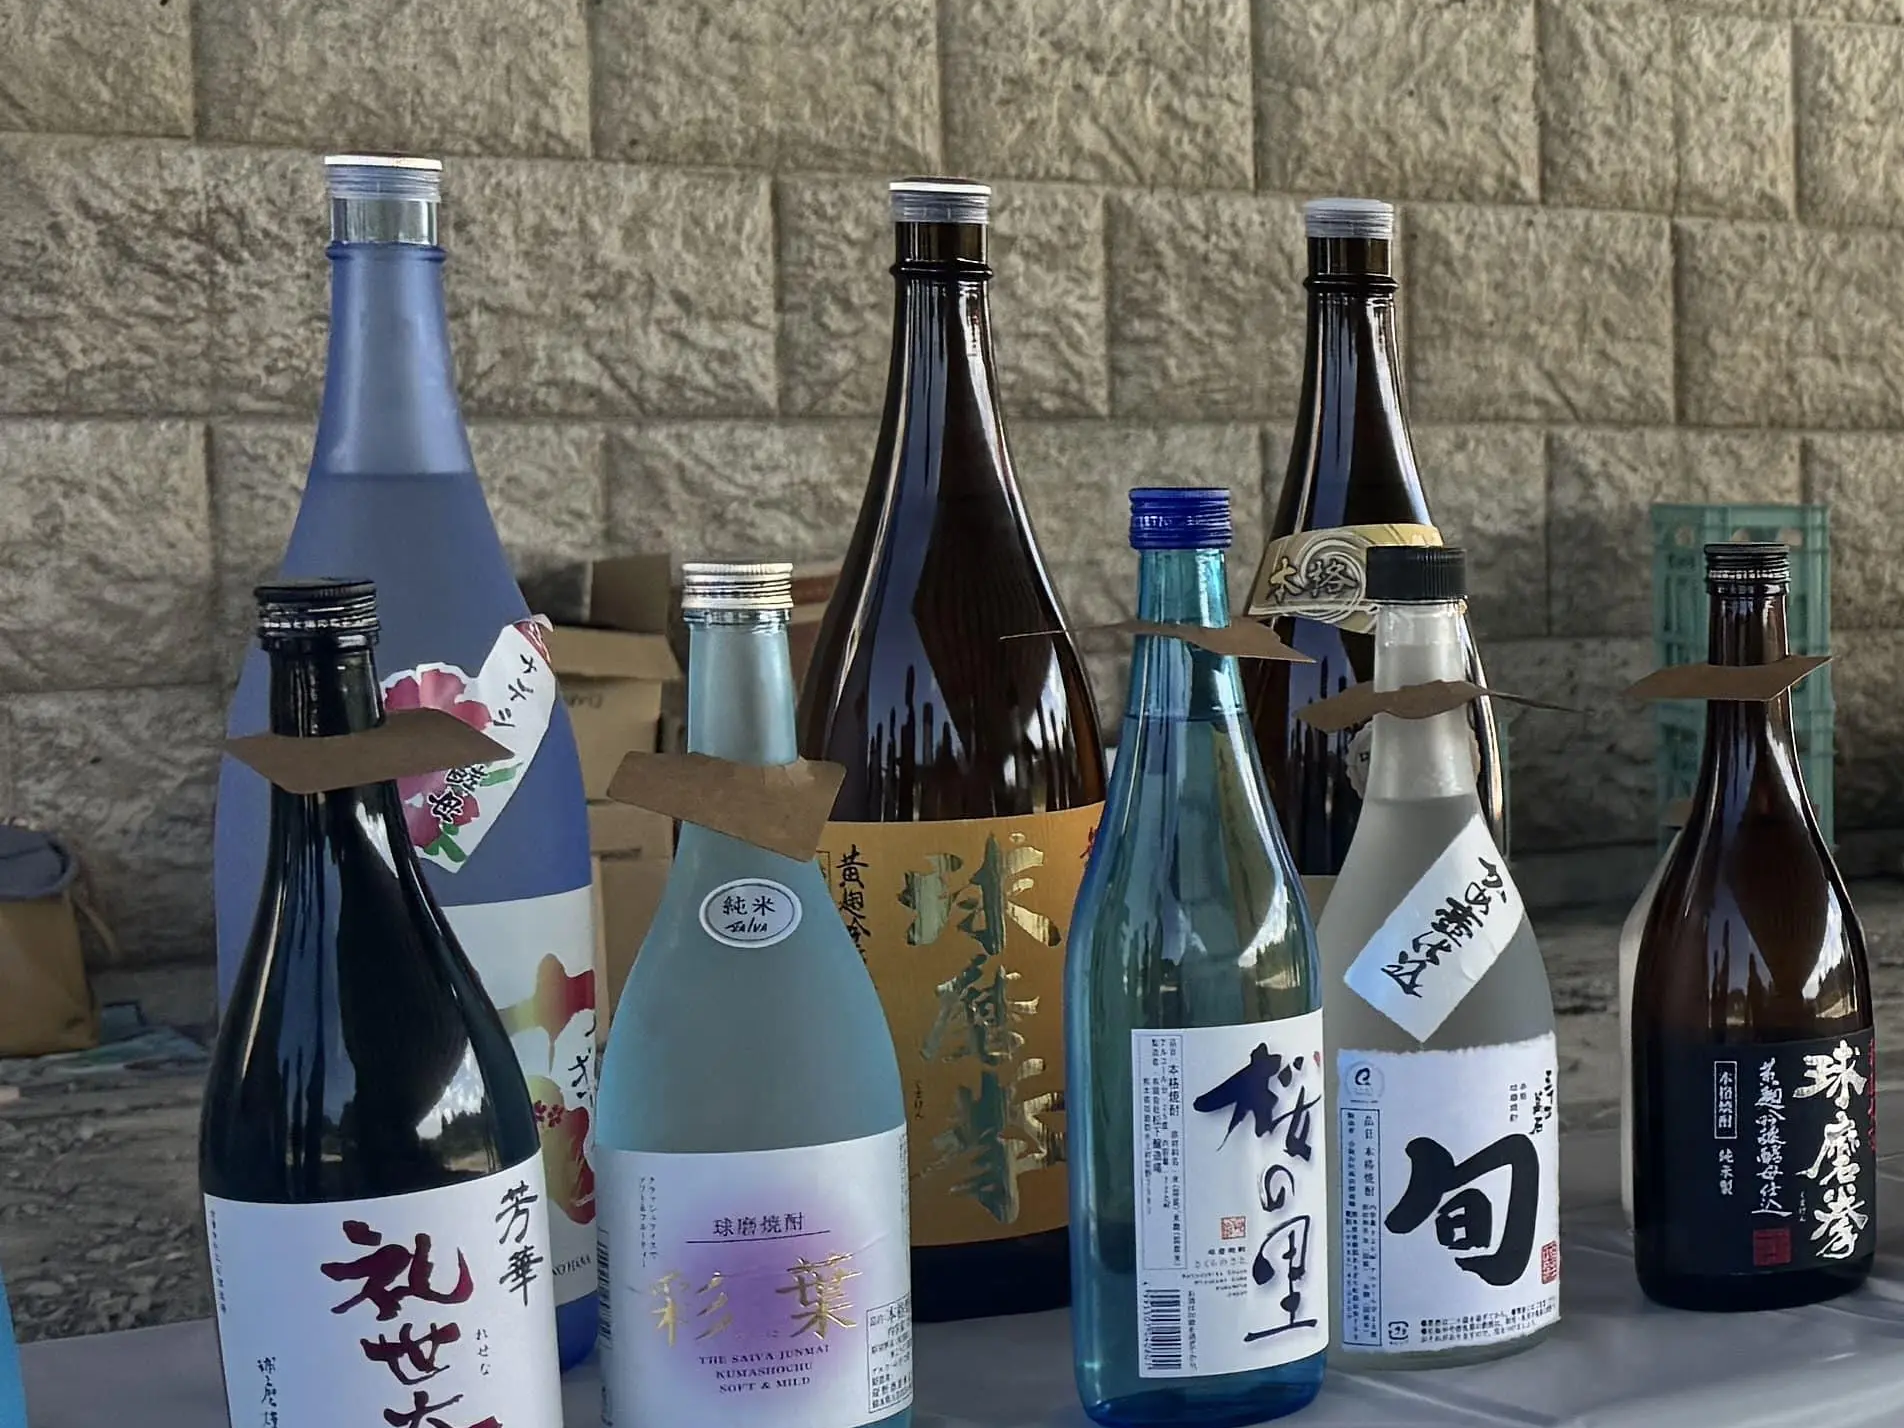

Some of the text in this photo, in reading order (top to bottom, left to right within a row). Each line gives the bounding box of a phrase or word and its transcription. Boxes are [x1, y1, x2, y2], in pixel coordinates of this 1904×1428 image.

[723, 895, 776, 917] 純米
[1792, 1039, 1868, 1259] 球磨拳
[1194, 1042, 1322, 1342] 桜の里
[1384, 1133, 1540, 1287] 旬
[712, 1212, 805, 1238] 球磨焼酎
[495, 1180, 545, 1307] 芳華
[699, 1355, 727, 1366] THE
[716, 1362, 813, 1380] KUMASHOCHU
[719, 1382, 757, 1394] SOFT
[776, 1376, 811, 1389] MILD
